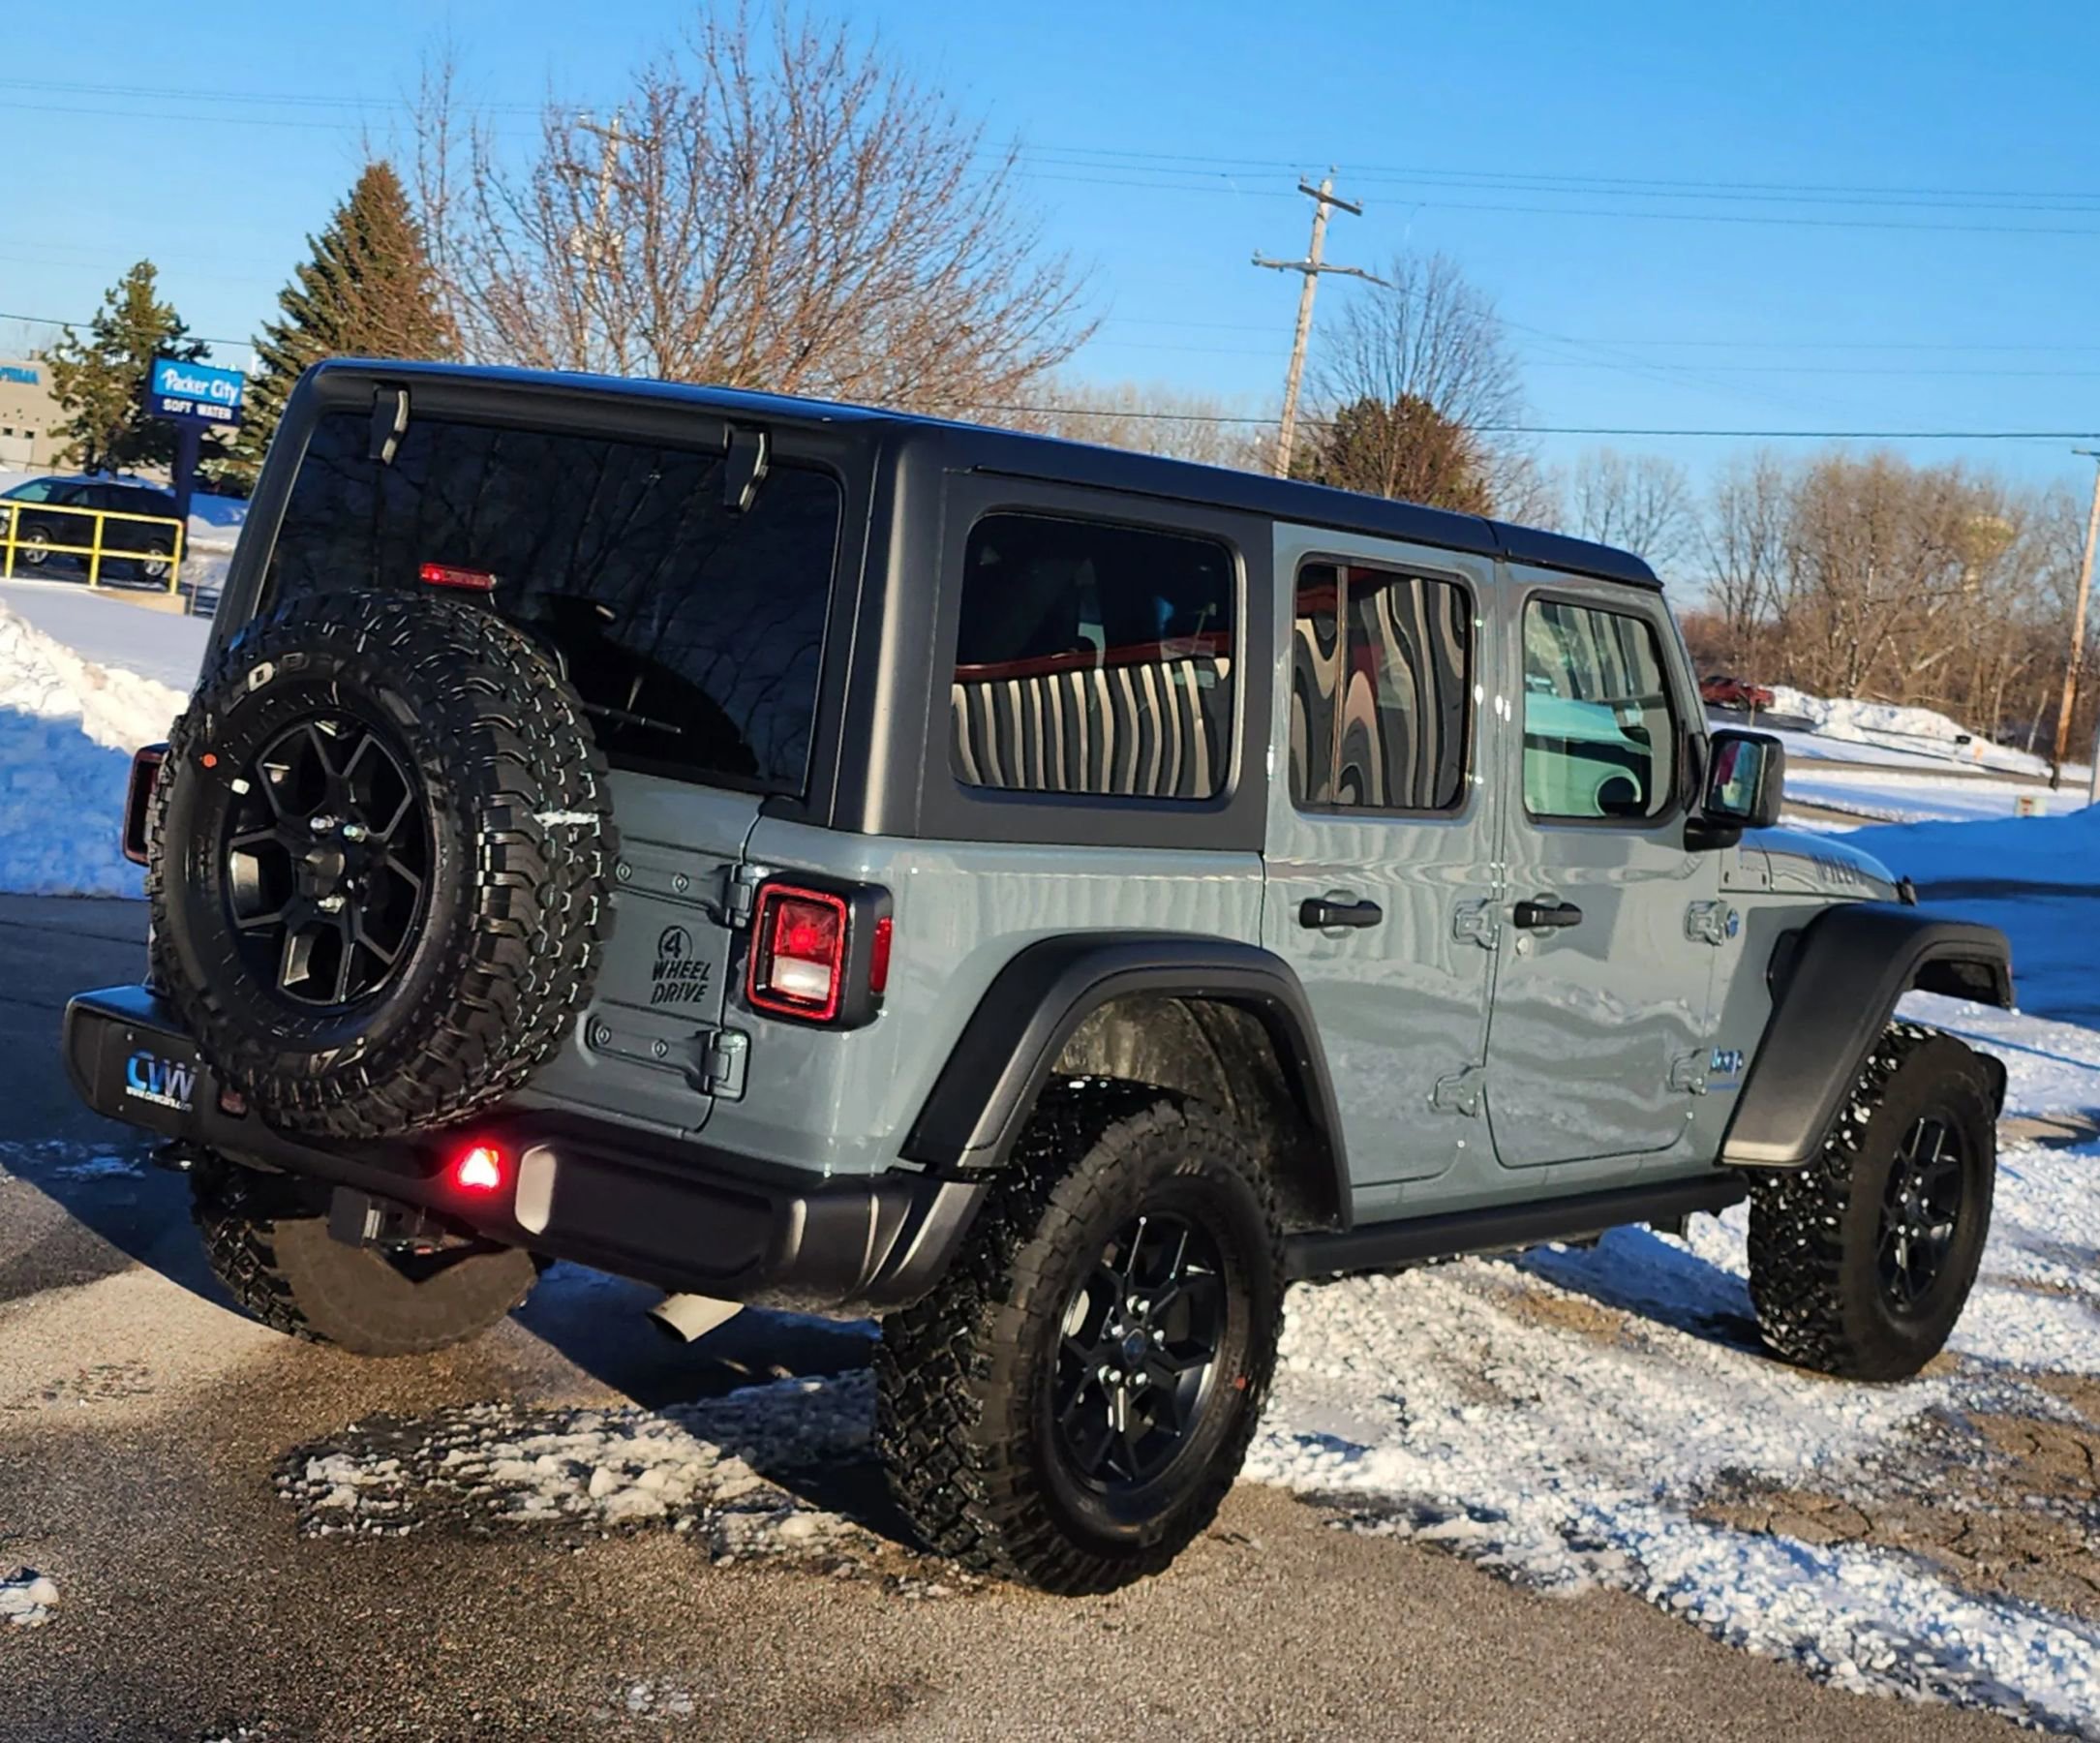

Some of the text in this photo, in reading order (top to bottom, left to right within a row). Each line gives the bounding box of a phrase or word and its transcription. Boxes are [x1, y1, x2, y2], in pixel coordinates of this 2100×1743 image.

[161, 368, 239, 407] Packer City
[163, 398, 232, 420] SOFT WATER
[652, 960, 712, 981] WHEEL
[650, 982, 708, 1005] DRIVE
